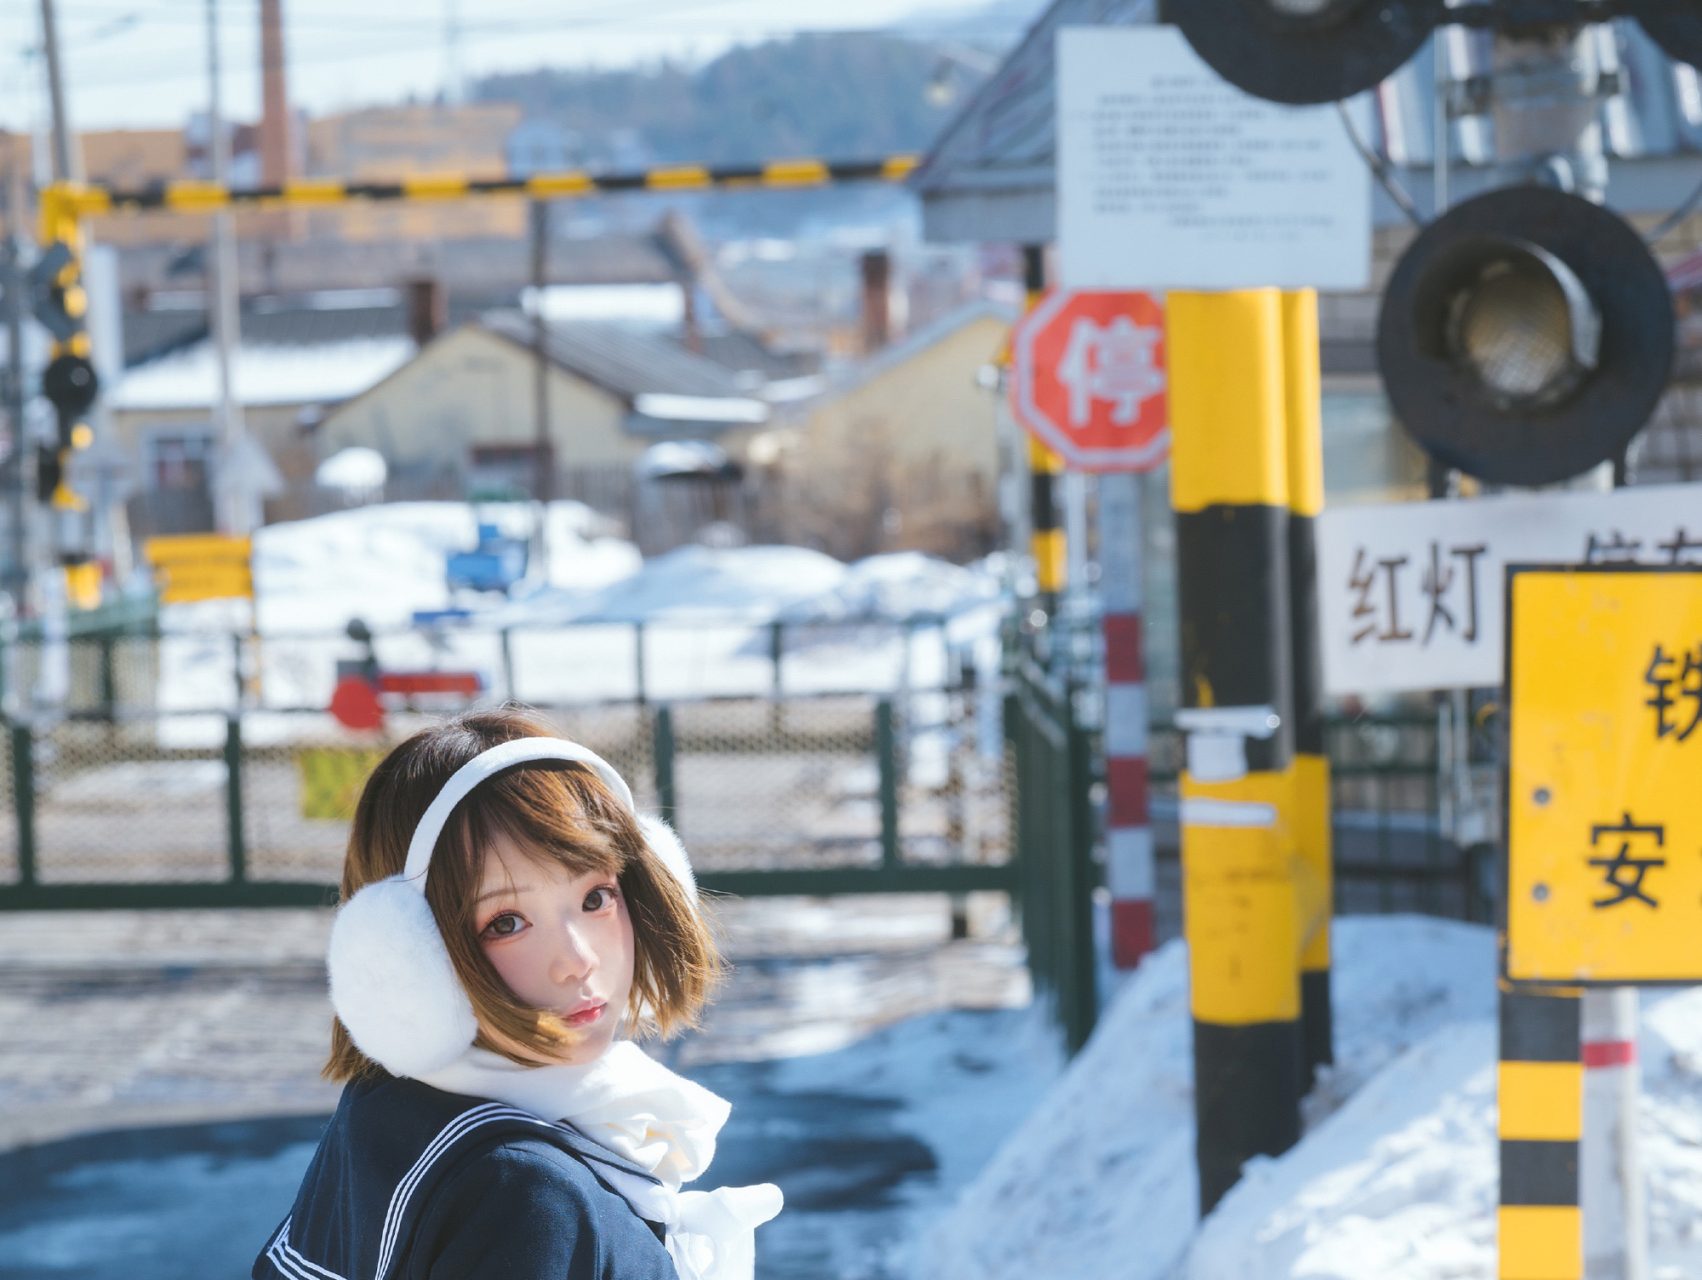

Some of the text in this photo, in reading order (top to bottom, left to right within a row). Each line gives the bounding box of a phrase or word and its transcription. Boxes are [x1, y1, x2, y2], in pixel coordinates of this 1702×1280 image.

[1056, 314, 1166, 428] 停
[1348, 541, 1487, 648] 红灯
[1587, 811, 1666, 909] 安
